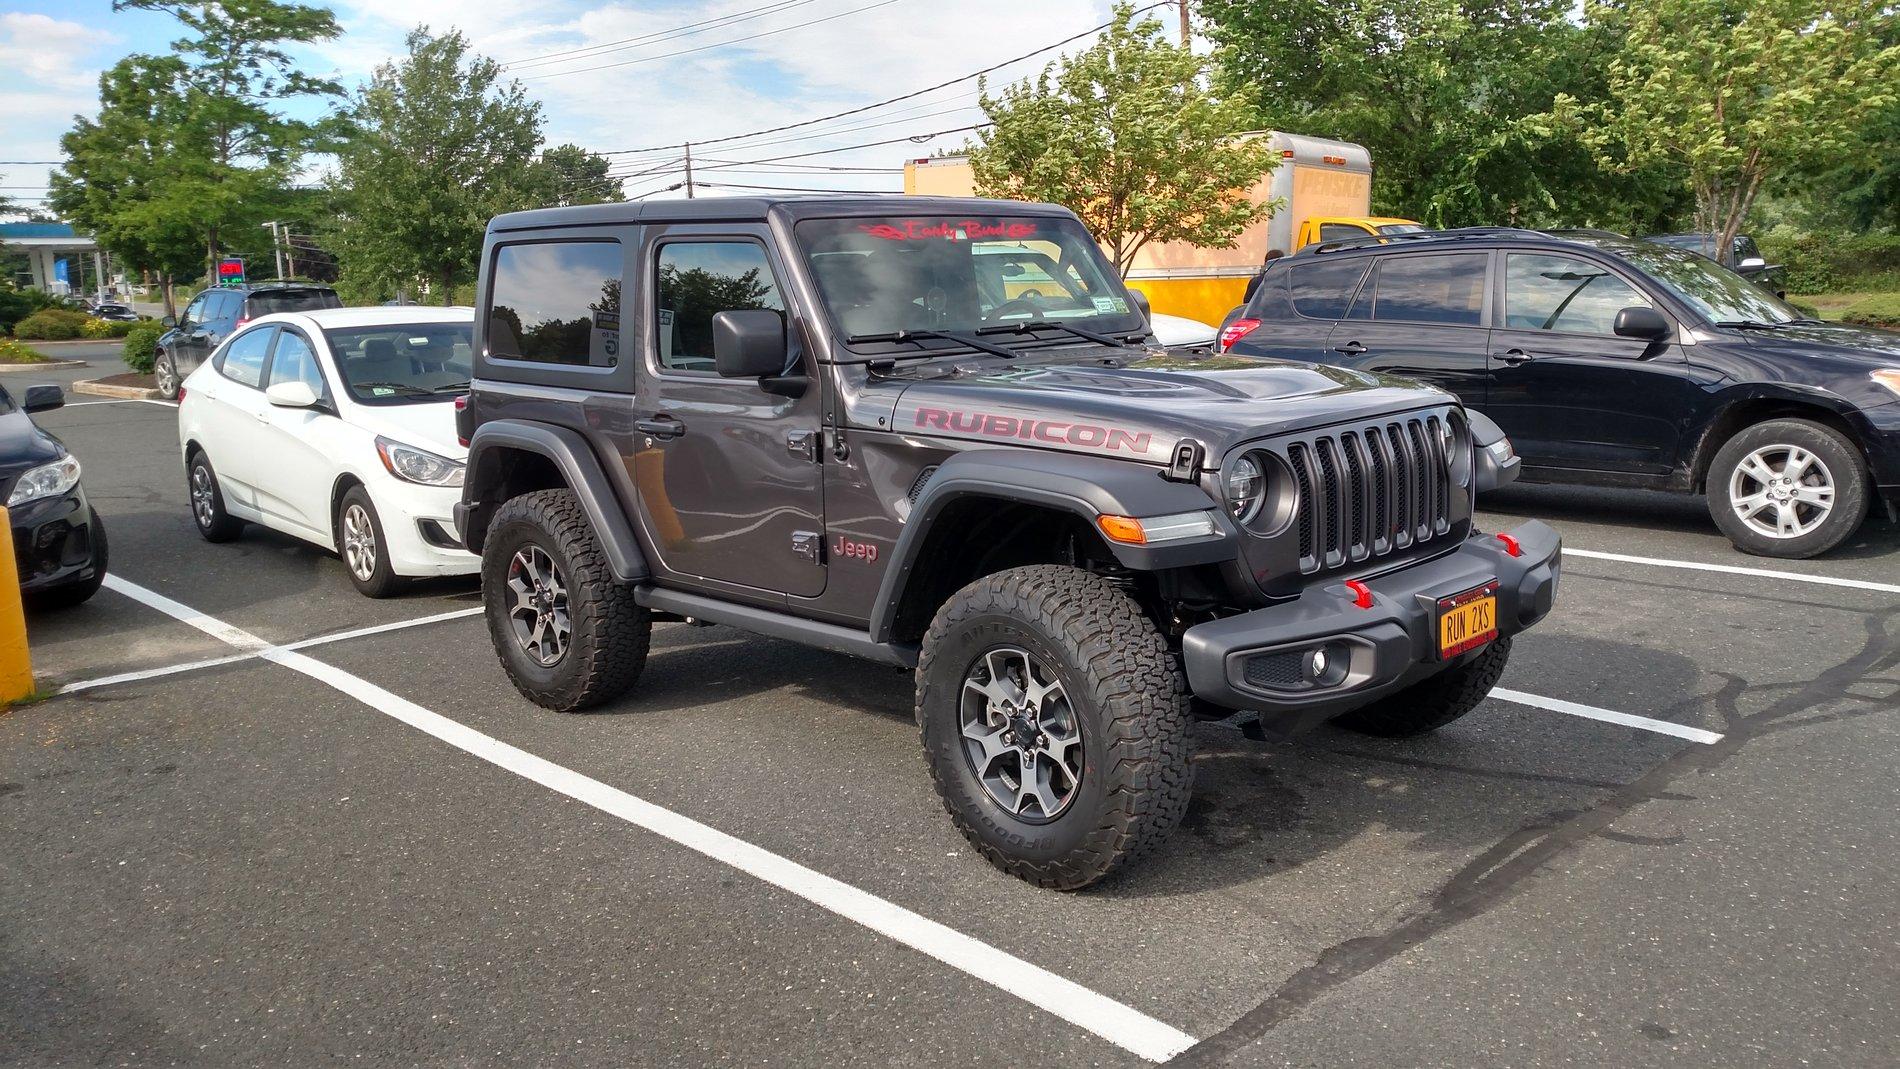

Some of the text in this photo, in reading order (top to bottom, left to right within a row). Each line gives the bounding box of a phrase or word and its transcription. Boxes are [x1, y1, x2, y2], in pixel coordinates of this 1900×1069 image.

[914, 407, 1152, 453] RUBICON
[833, 536, 879, 565] Jeep
[1447, 602, 1489, 643] RUN 2XS
